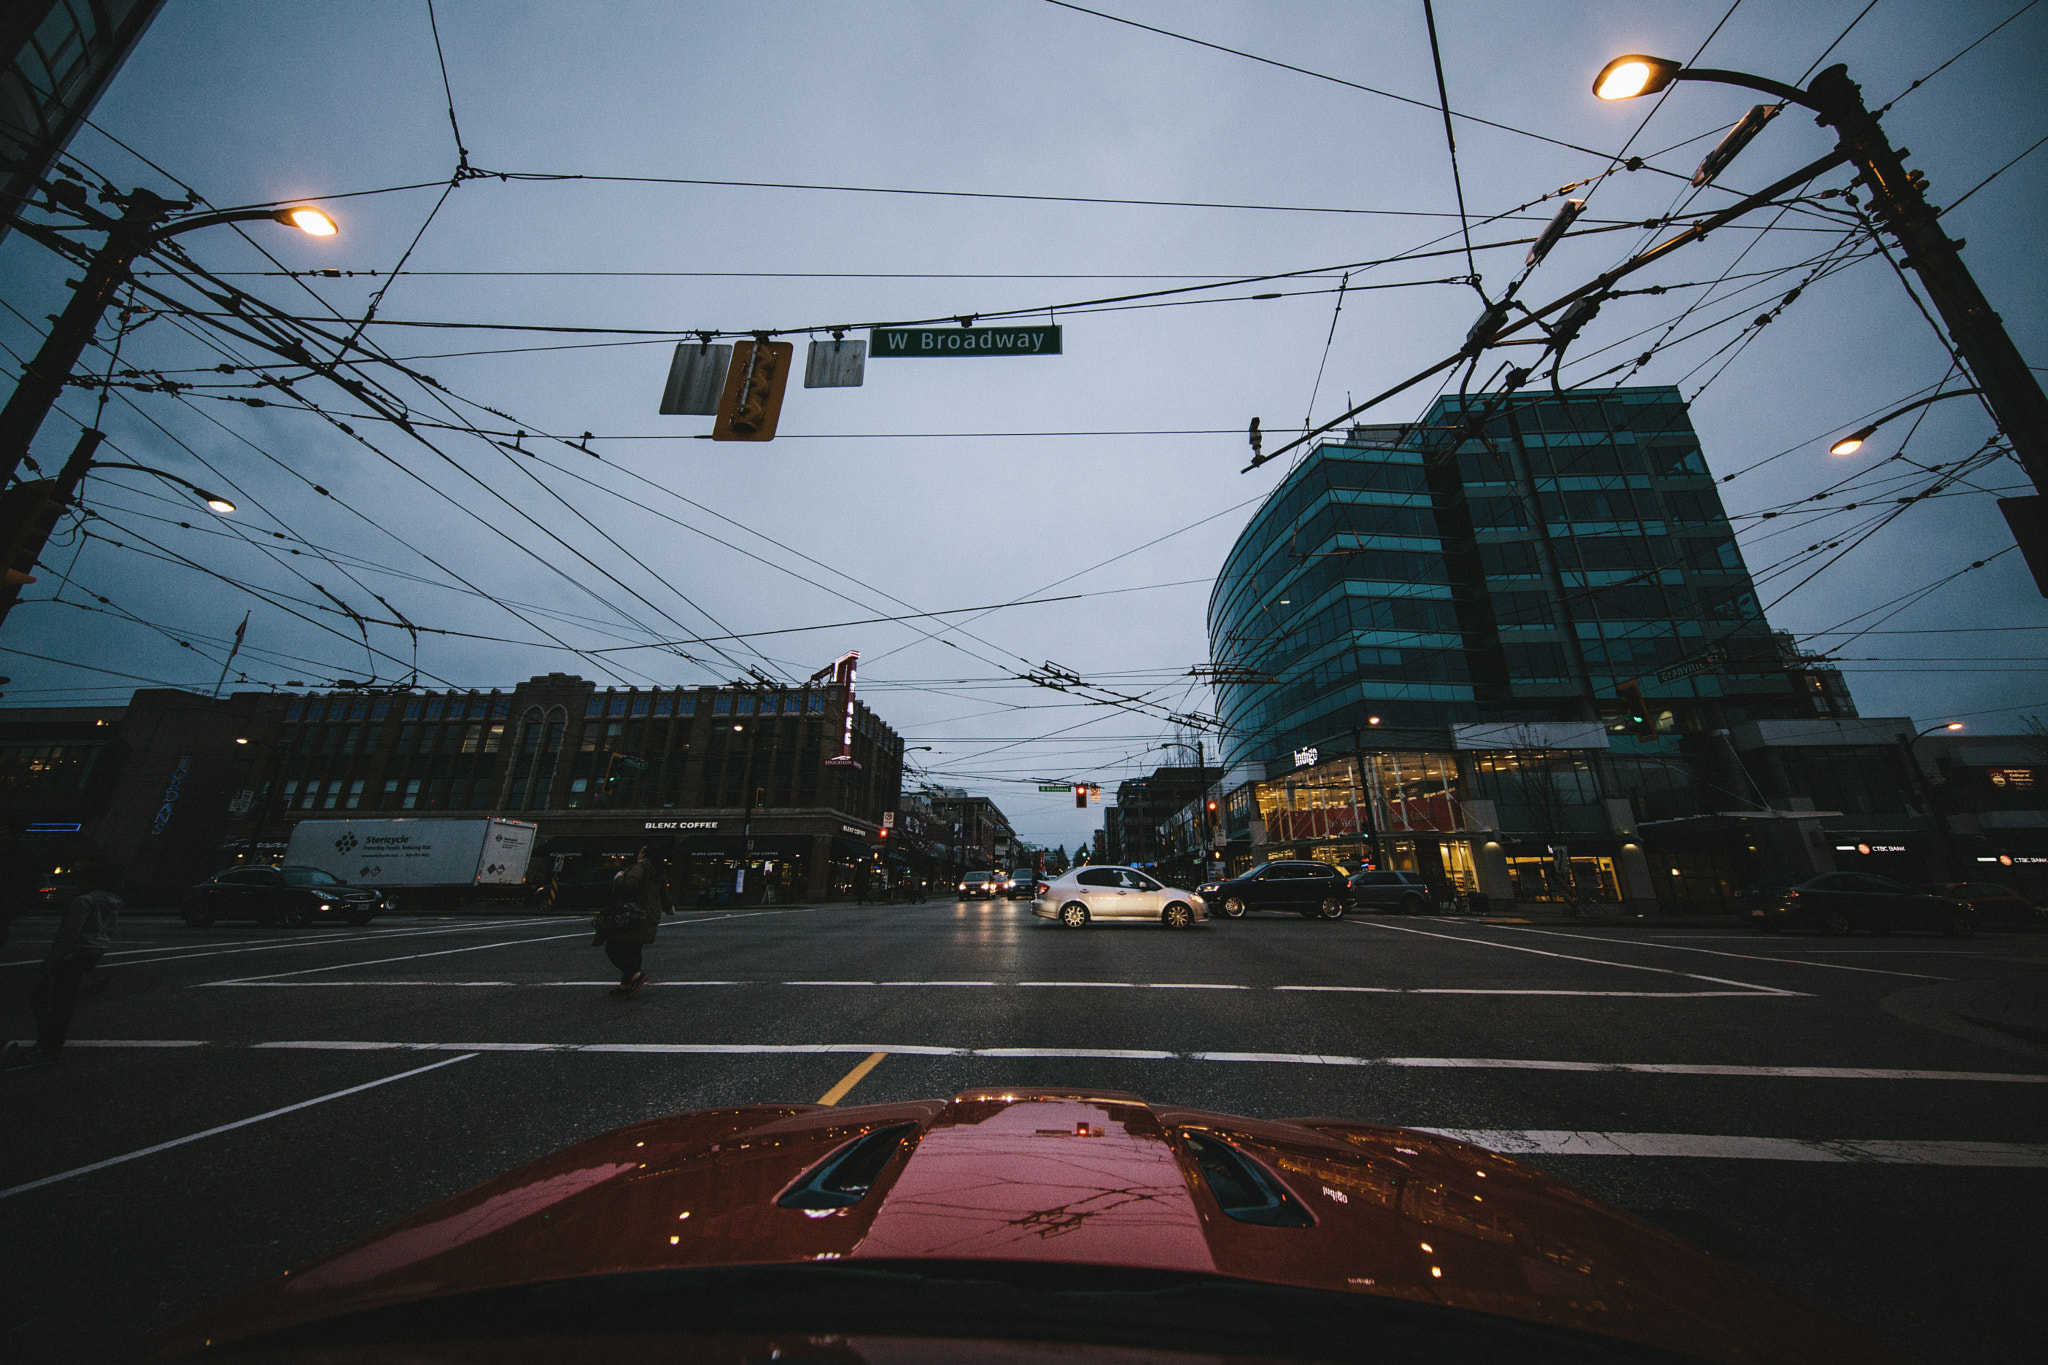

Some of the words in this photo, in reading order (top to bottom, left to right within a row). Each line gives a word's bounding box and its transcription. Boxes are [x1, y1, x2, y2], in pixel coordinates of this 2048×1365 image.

[888, 332, 908, 350] W
[921, 330, 1044, 352] Broadway
[1293, 745, 1319, 767] Indigo
[151, 755, 192, 835] JORDANS
[645, 822, 677, 830] BLENZ
[679, 821, 719, 830] COFFEE
[365, 835, 410, 846] Stericycle
